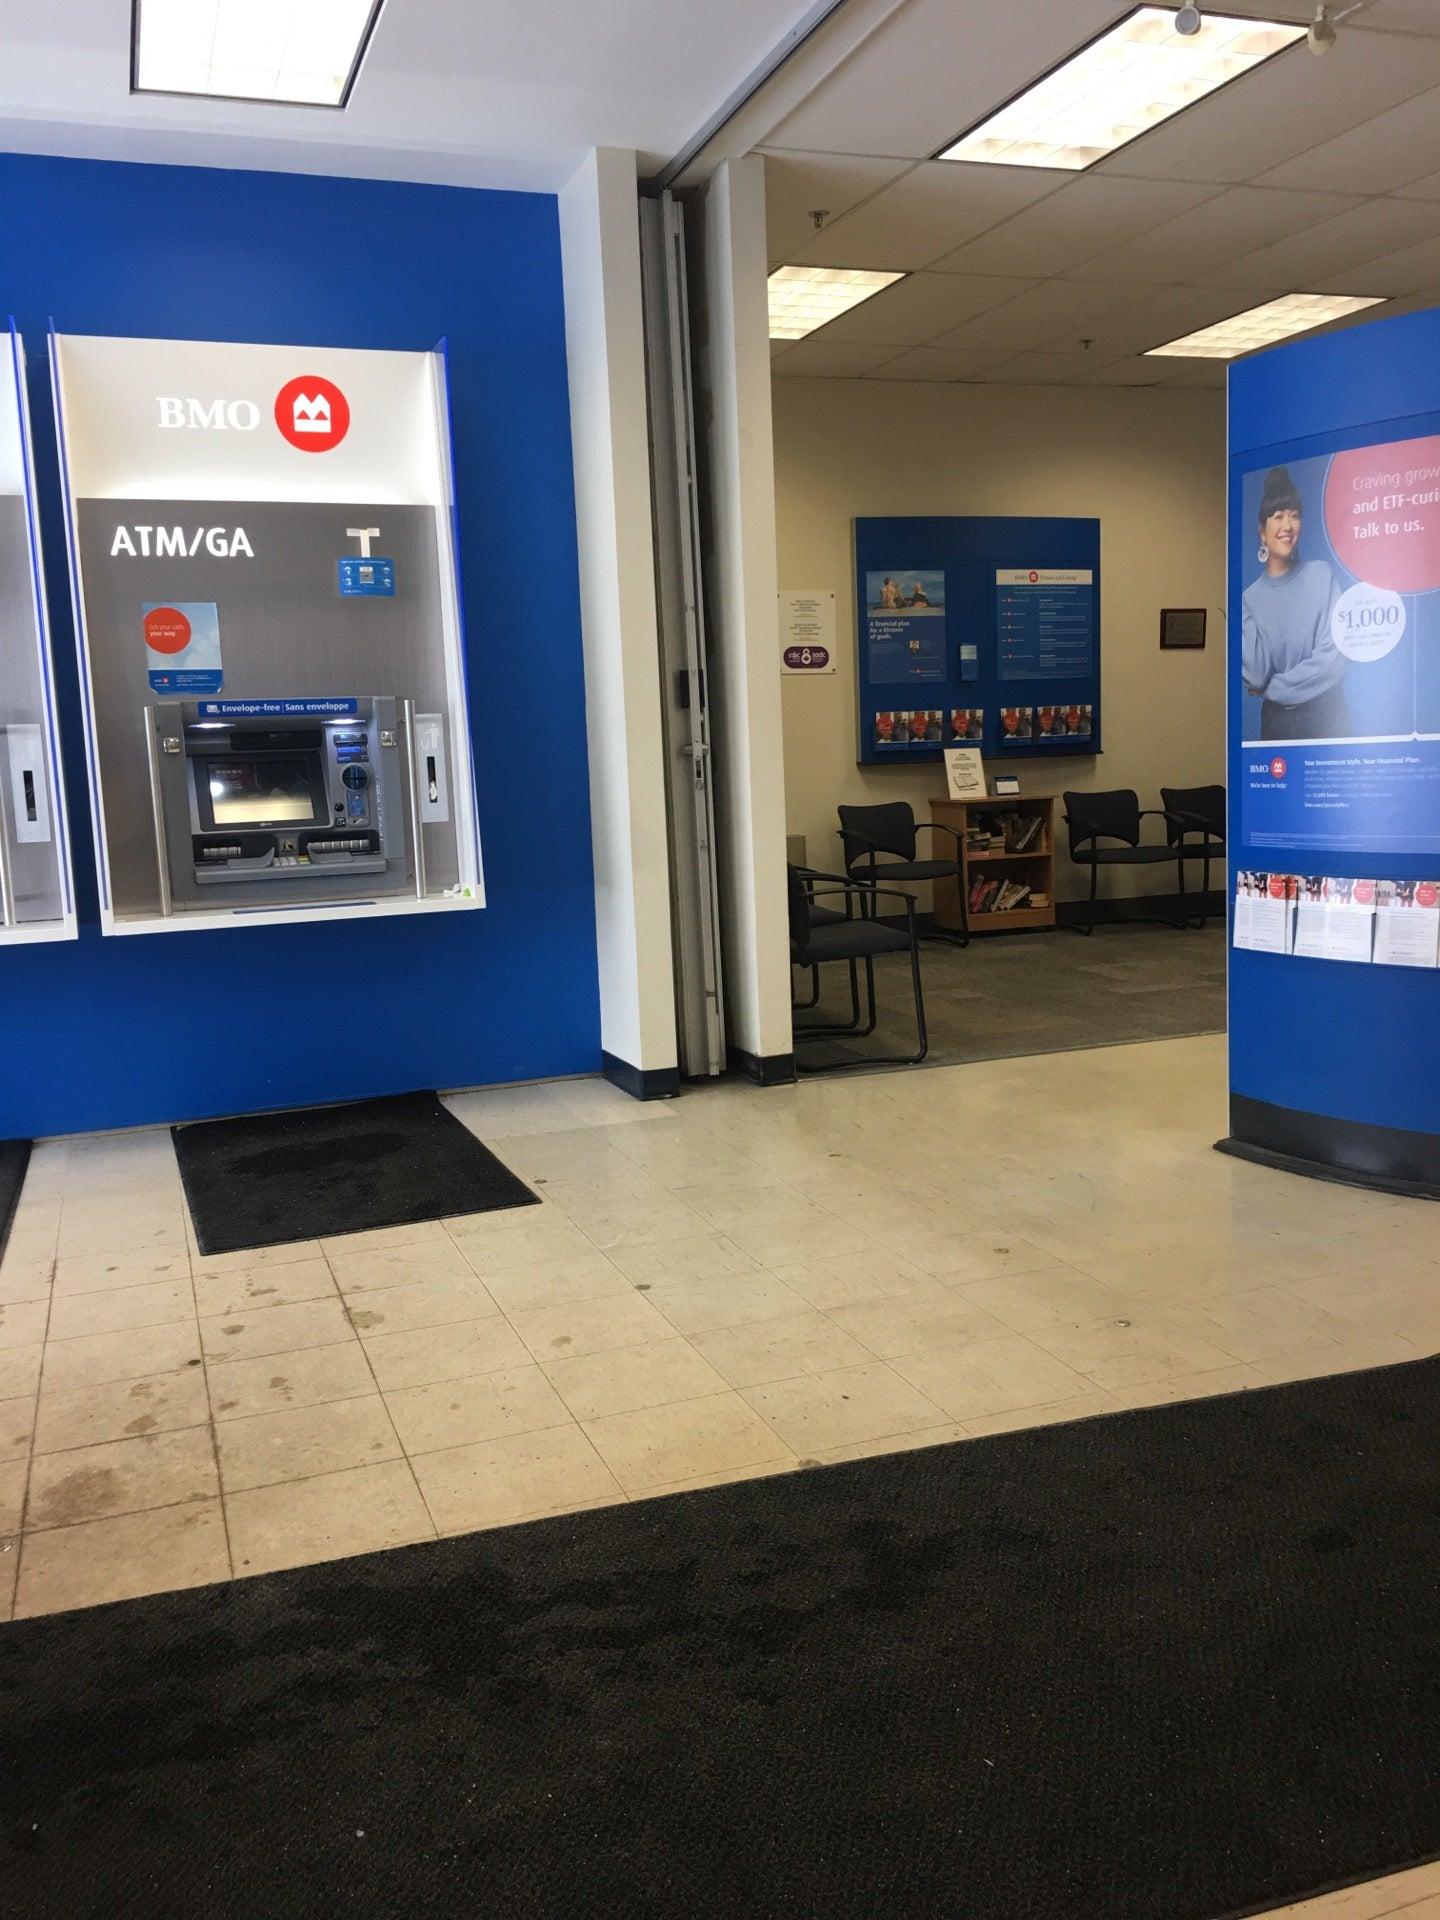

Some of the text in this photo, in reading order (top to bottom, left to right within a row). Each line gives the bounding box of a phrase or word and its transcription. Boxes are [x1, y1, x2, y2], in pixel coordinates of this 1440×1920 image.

[156, 397, 260, 431] BMO
[1352, 466, 1440, 491] Craving grow
[1352, 488, 1440, 514] and ETF-curi
[110, 525, 255, 557] ATM/GA
[1353, 519, 1425, 539] Talk to us.
[1337, 605, 1399, 632] $1,000
[222, 702, 350, 713] Envelope-free Sans enveloppe
[1249, 764, 1269, 774] BMO
